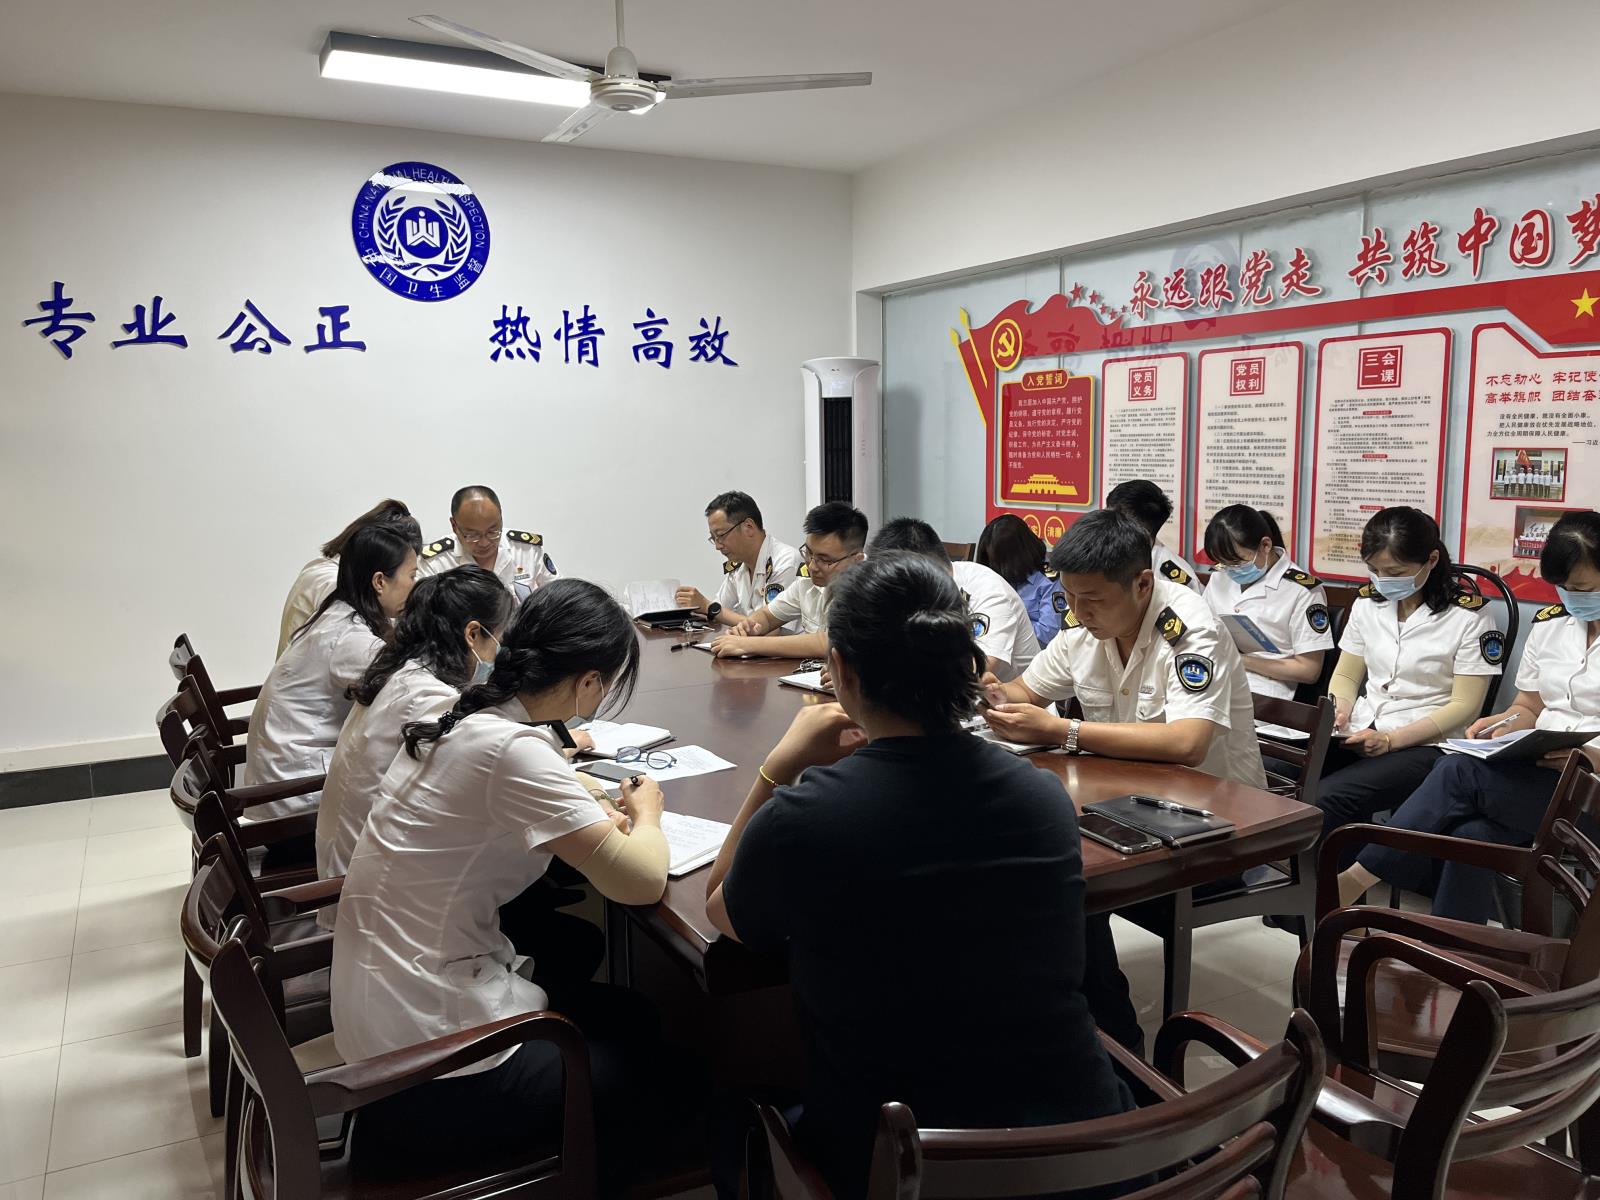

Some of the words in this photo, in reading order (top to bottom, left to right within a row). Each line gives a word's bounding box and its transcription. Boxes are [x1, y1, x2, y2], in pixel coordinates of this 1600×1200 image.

[358, 203, 370, 239] CHINA
[412, 168, 455, 184] HEALT
[1129, 246, 1322, 321] 永远跟党走
[1347, 193, 1600, 287] 共筑中国梦
[24, 281, 367, 360] 专业公正
[489, 304, 738, 369] 热情高效
[1364, 352, 1396, 366] 三会
[1236, 363, 1260, 376] 党员
[1364, 369, 1395, 382] 一课
[1027, 373, 1063, 386] 入党誓词
[1132, 371, 1153, 383] 党员
[1485, 373, 1543, 386] 不忘初心
[1552, 371, 1600, 384] 牢记使
[1132, 385, 1153, 397] 义务
[1235, 378, 1260, 391] 权利
[1485, 391, 1541, 404] 高举旗帜
[1552, 389, 1600, 402] 团结奋
